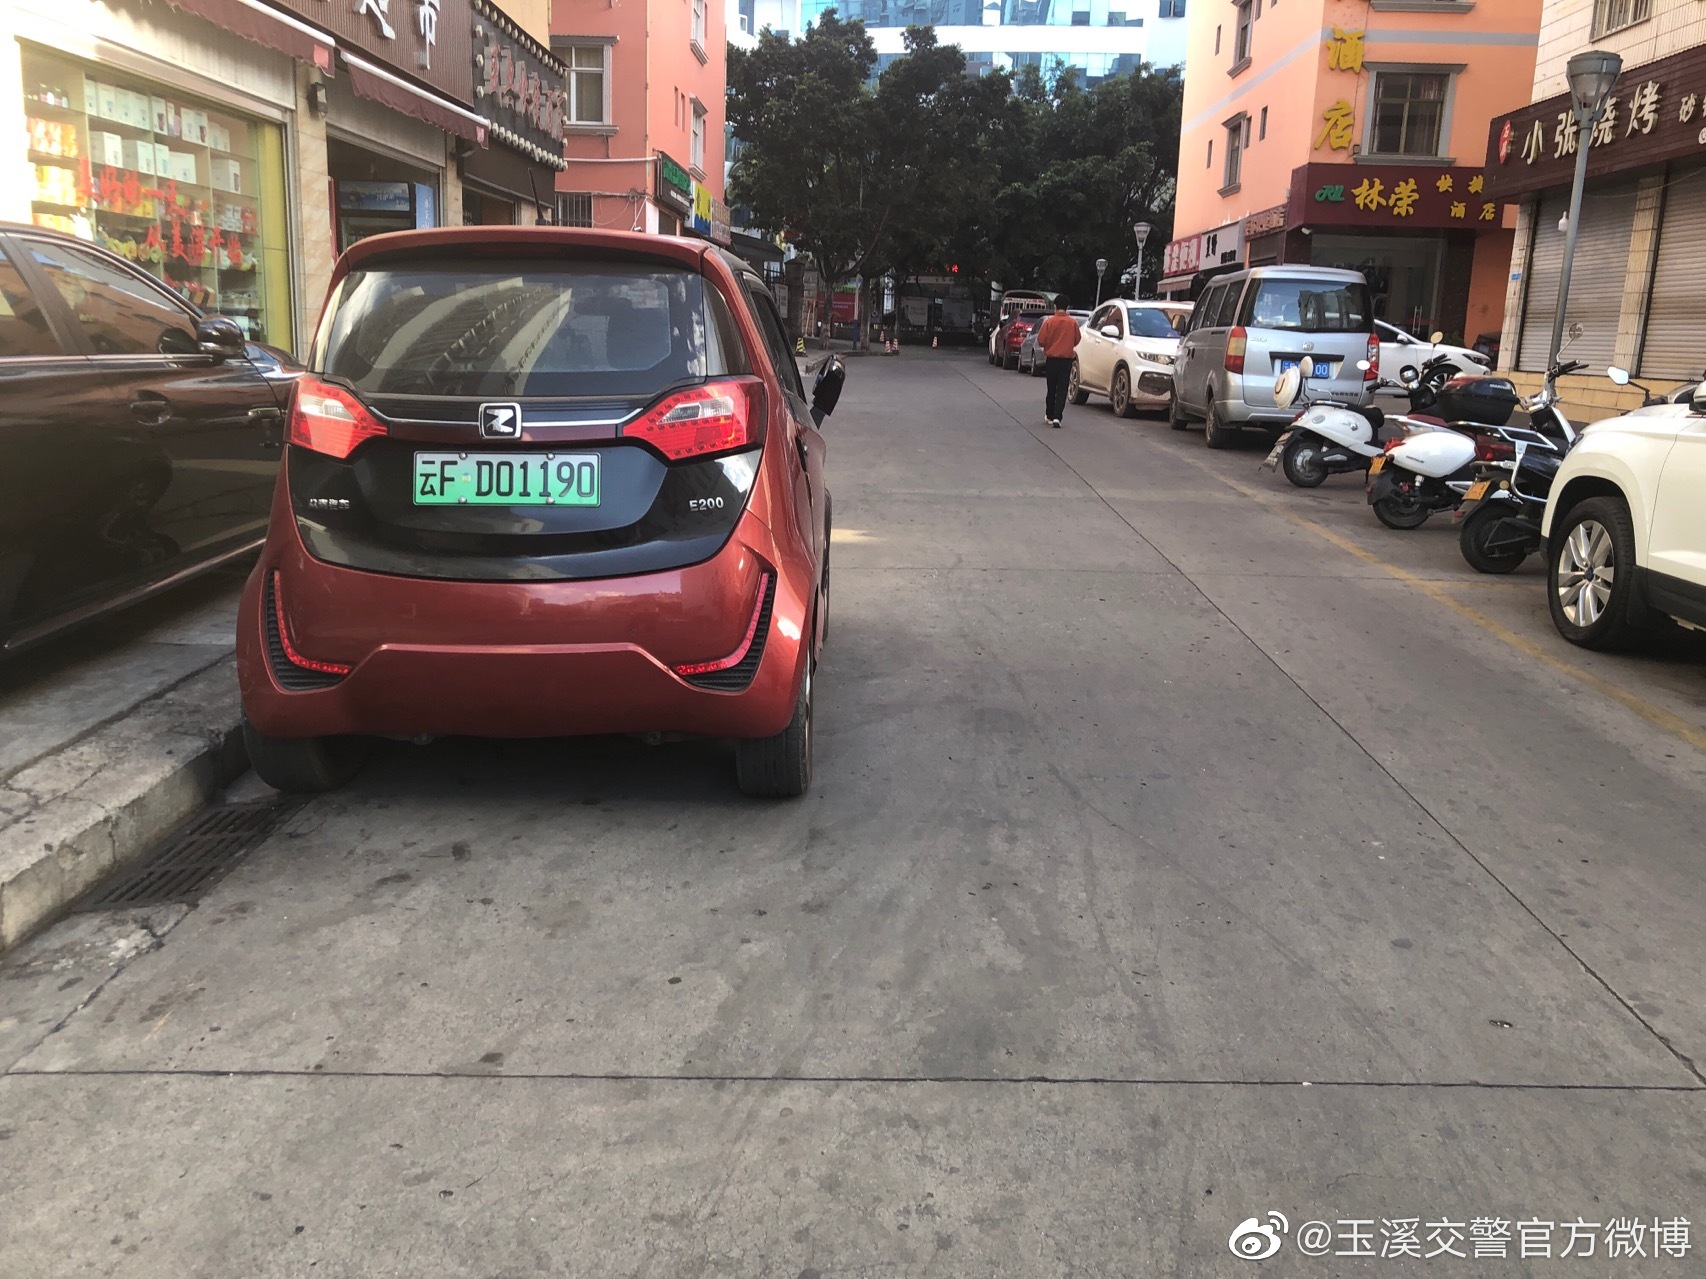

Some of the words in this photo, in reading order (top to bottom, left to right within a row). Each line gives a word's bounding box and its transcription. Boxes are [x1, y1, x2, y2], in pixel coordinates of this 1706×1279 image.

[1314, 25, 1365, 150] 酒店
[1521, 81, 1660, 165] 小张烧烤
[1351, 177, 1420, 217] 林荣
[1451, 201, 1496, 221] 酒店
[689, 496, 725, 511] E200
